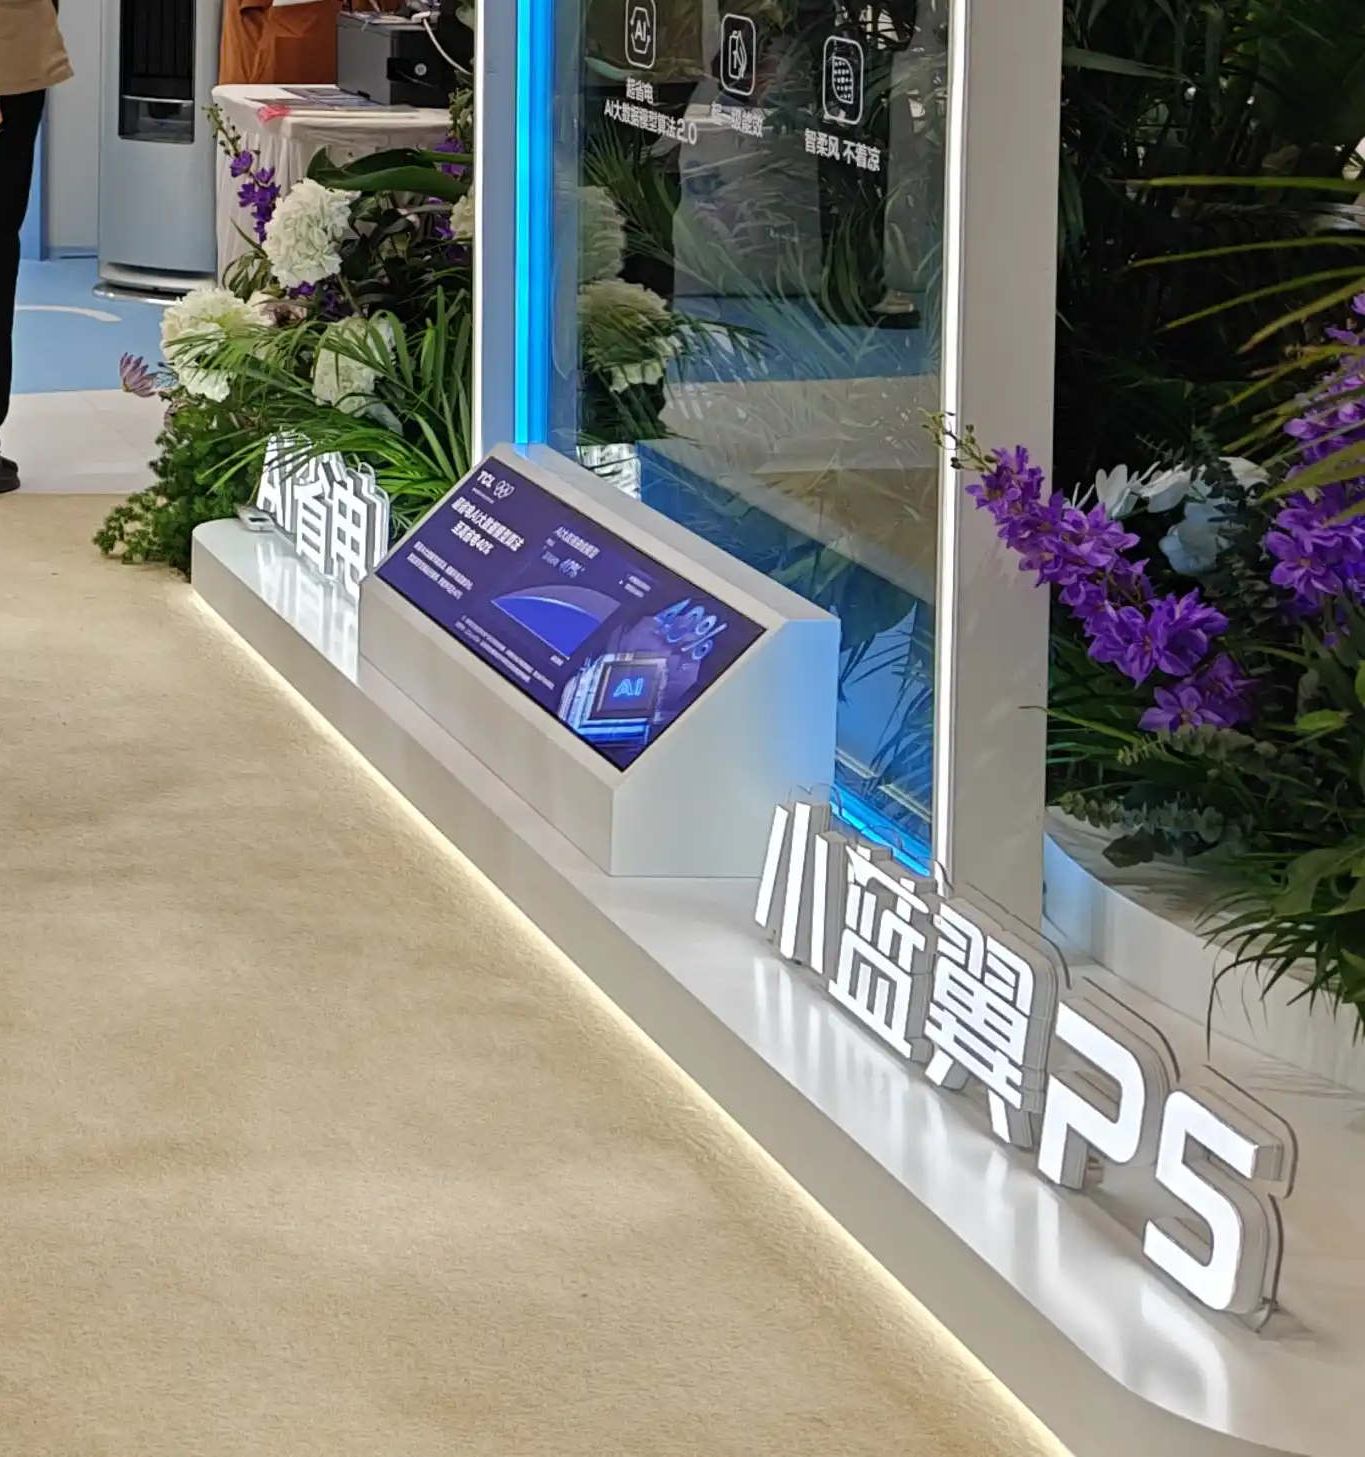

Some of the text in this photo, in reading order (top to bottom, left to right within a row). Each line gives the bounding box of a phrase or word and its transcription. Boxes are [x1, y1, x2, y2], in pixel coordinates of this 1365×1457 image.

[842, 139, 881, 172] 不着凉
[474, 469, 498, 488] TCL
[613, 677, 644, 697] AI
[755, 800, 1259, 1312] 小蓝翼P5
